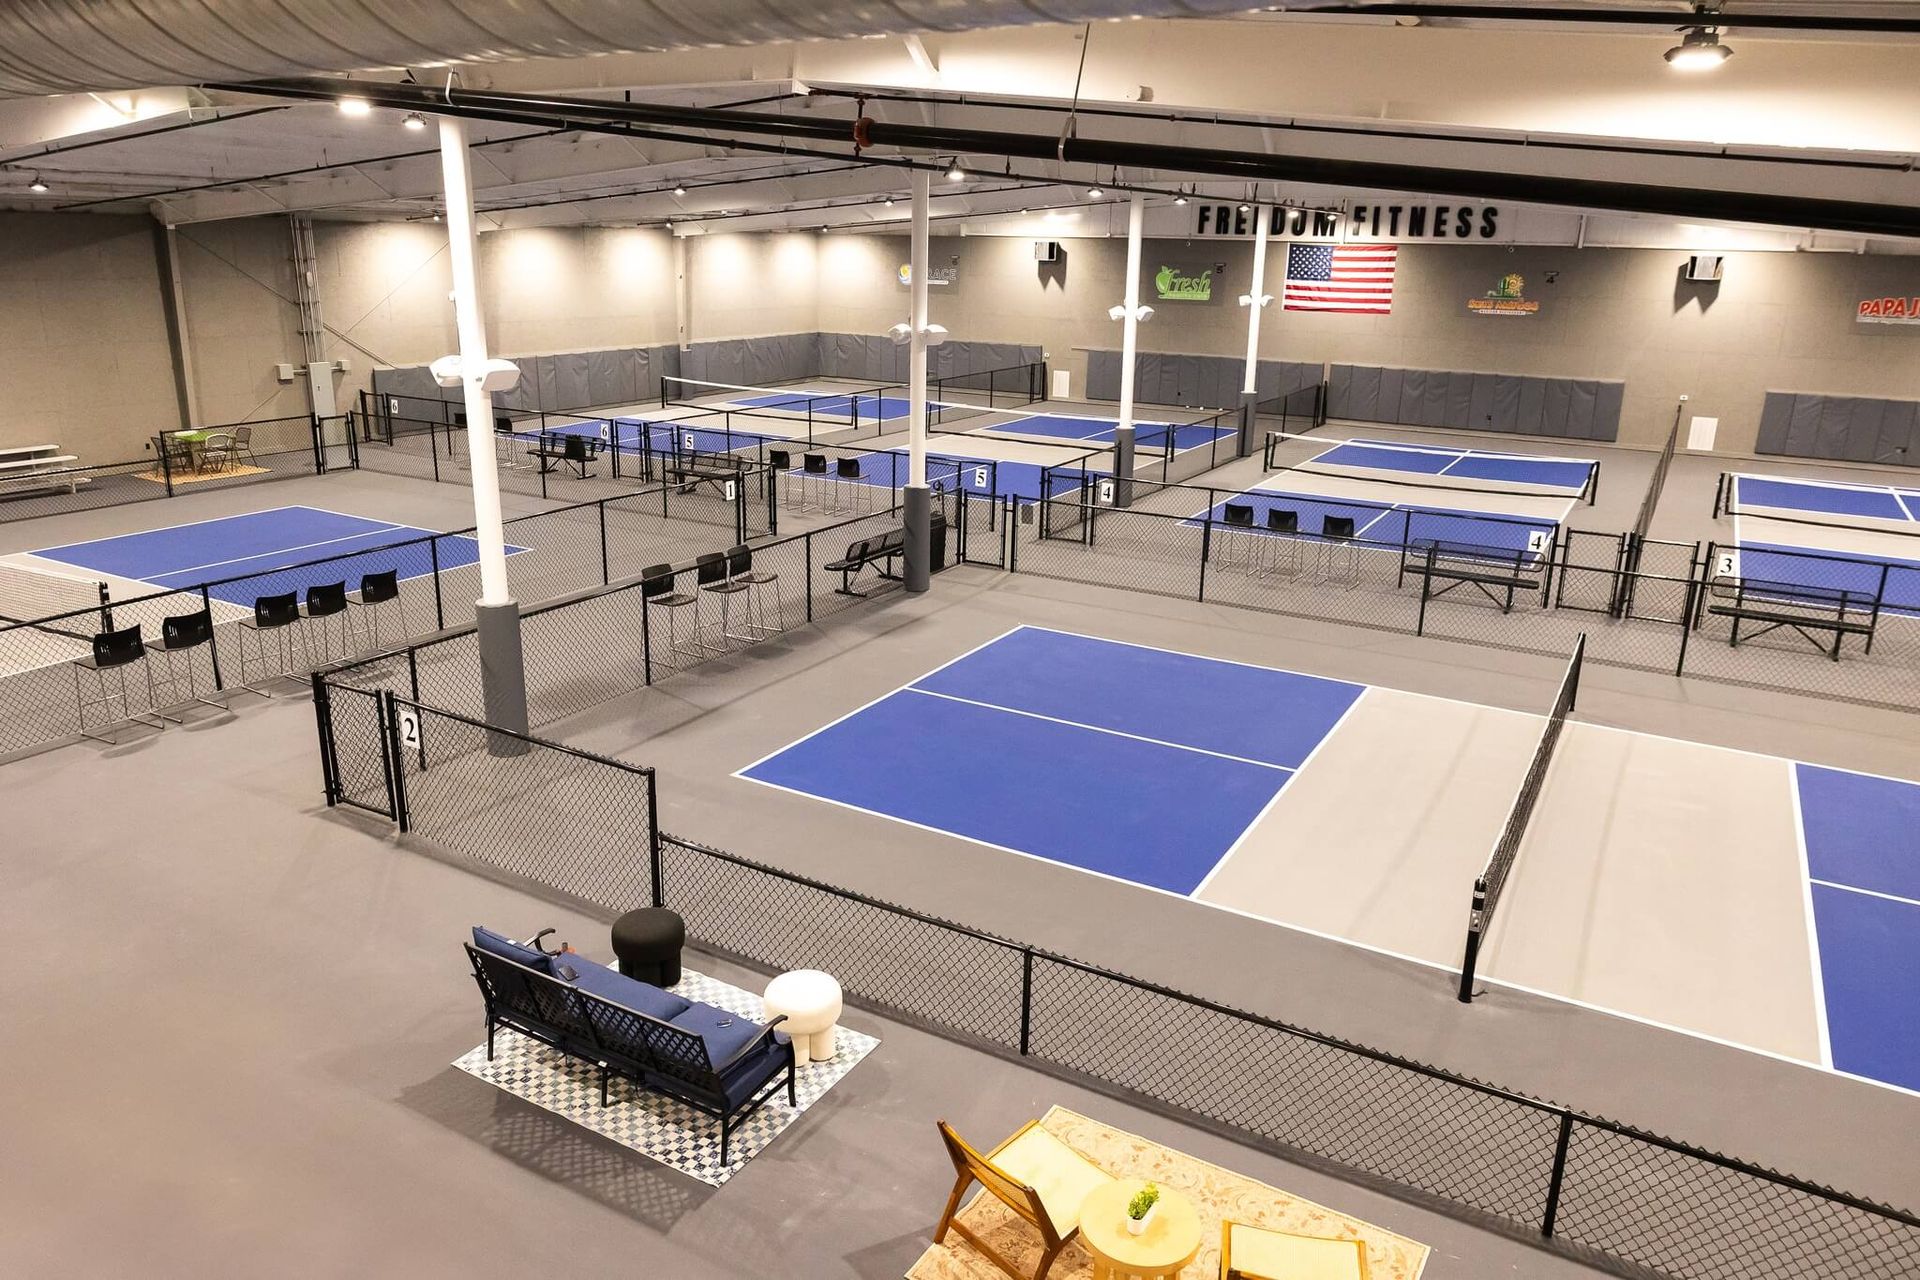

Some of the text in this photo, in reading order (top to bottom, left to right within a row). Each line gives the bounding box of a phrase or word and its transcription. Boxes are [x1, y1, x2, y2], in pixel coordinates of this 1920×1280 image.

[1352, 206, 1498, 238] FITNESS
[1859, 297, 1907, 316] PAPA
[602, 426, 608, 437] 6
[686, 437, 692, 448] 5
[977, 472, 985, 484] 5
[1103, 486, 1111, 499] 4
[1531, 535, 1542, 549] 4
[1720, 558, 1732, 573] 3
[404, 717, 416, 742] 2
